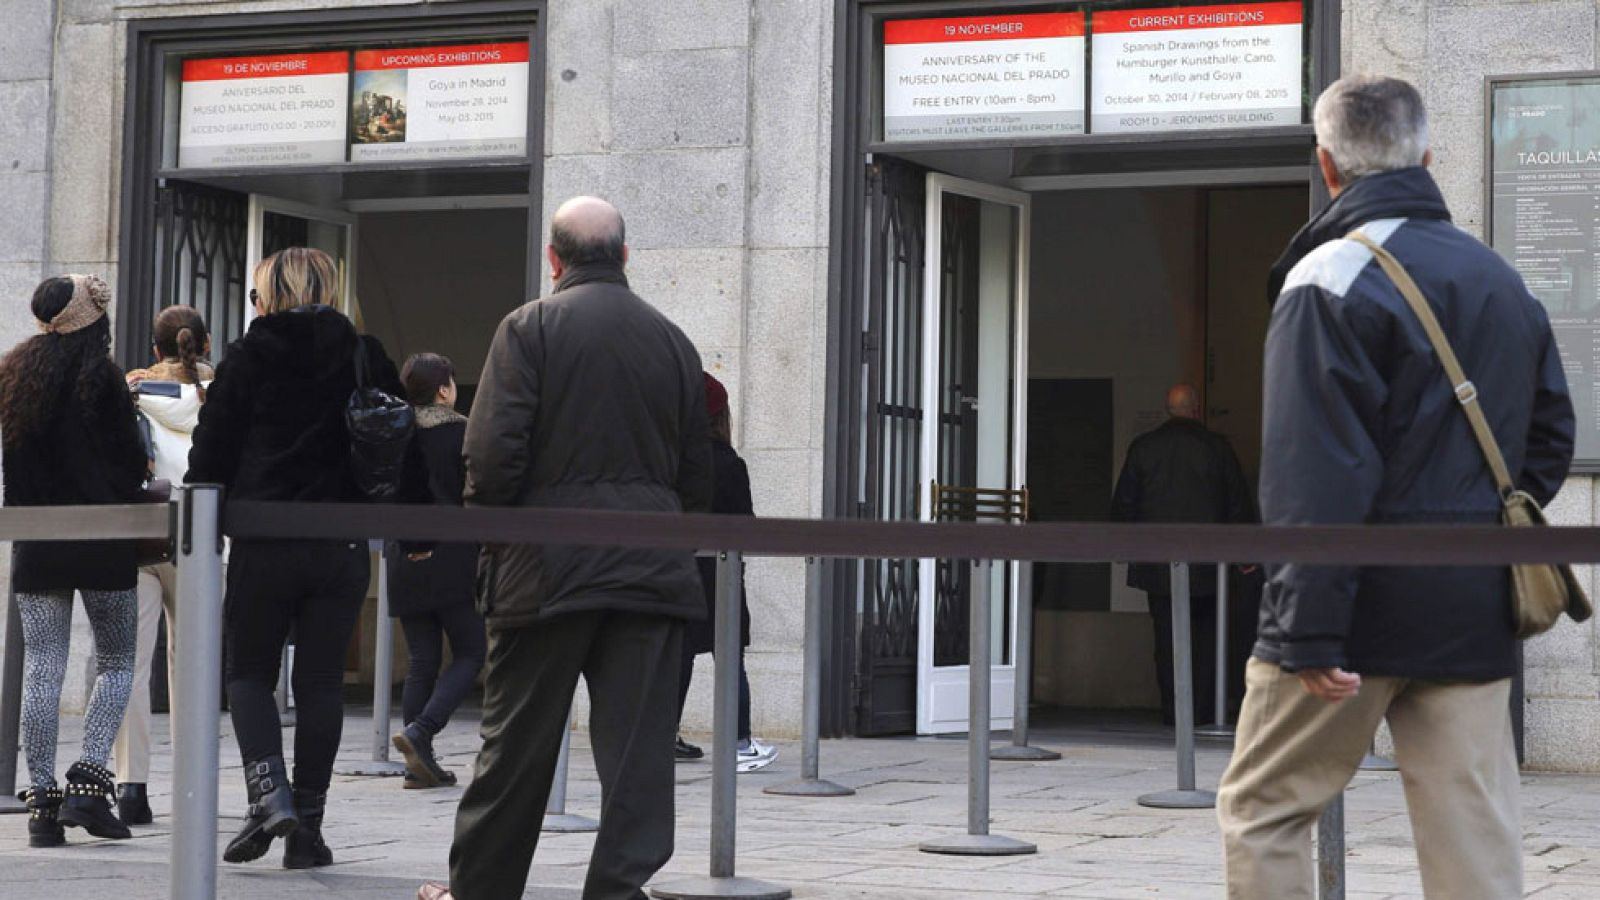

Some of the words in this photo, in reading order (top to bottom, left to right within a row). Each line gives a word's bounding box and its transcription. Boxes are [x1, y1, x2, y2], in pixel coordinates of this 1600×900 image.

[1129, 15, 1184, 28] CURRENT
[1188, 11, 1264, 25] EXHIBITIONS
[945, 26, 955, 35] 19
[959, 22, 1023, 34] NOVEMBER
[1122, 41, 1165, 54] Spanish
[1169, 40, 1218, 51] Drawings
[1222, 37, 1248, 47] from
[1252, 36, 1270, 46] the
[382, 55, 435, 65] UPCOMING
[438, 51, 501, 63] EXHIBITIONS
[922, 55, 1001, 66] ANNIVERSARY
[1005, 53, 1020, 63] OF
[1025, 52, 1046, 62] THE
[1117, 57, 1178, 70] Hamburger
[223, 64, 232, 74] 19
[235, 63, 248, 73] DE
[250, 60, 307, 72] NOVIEMBRE
[900, 75, 938, 85] MUSEO
[942, 73, 1000, 84] NACIONAL
[1004, 72, 1025, 81] DEL
[1029, 70, 1070, 80] PRADO
[1149, 74, 1185, 83] Murillo
[1189, 72, 1209, 81] and
[1213, 70, 1242, 82] Goya
[222, 86, 286, 97] ANIVERSARIO
[288, 84, 305, 94] DEL
[429, 79, 455, 92] Goya
[458, 79, 467, 88] in
[470, 77, 506, 87] Madrid
[425, 100, 470, 109] November
[488, 96, 508, 105] 2014
[913, 98, 940, 107] FREE
[944, 96, 981, 107] ENTRY
[984, 95, 1016, 106] (10am
[1026, 93, 1055, 105] 8pm)
[1105, 95, 1144, 105] October
[1166, 92, 1188, 103] 2014
[1199, 90, 1242, 102] February
[1264, 89, 1288, 98] 2015
[193, 105, 226, 114] MUSEO
[228, 101, 276, 112] NACIONAL
[281, 100, 297, 110] DEL
[301, 99, 335, 109] PRADO
[438, 114, 456, 124] May
[474, 112, 494, 121] 2015
[967, 116, 992, 124] ENTRY
[1120, 117, 1150, 127] ROOM
[1152, 116, 1159, 125] D
[1228, 112, 1274, 123] BUILDING
[191, 125, 224, 134] ACCESO
[227, 123, 269, 133] GRATUITO
